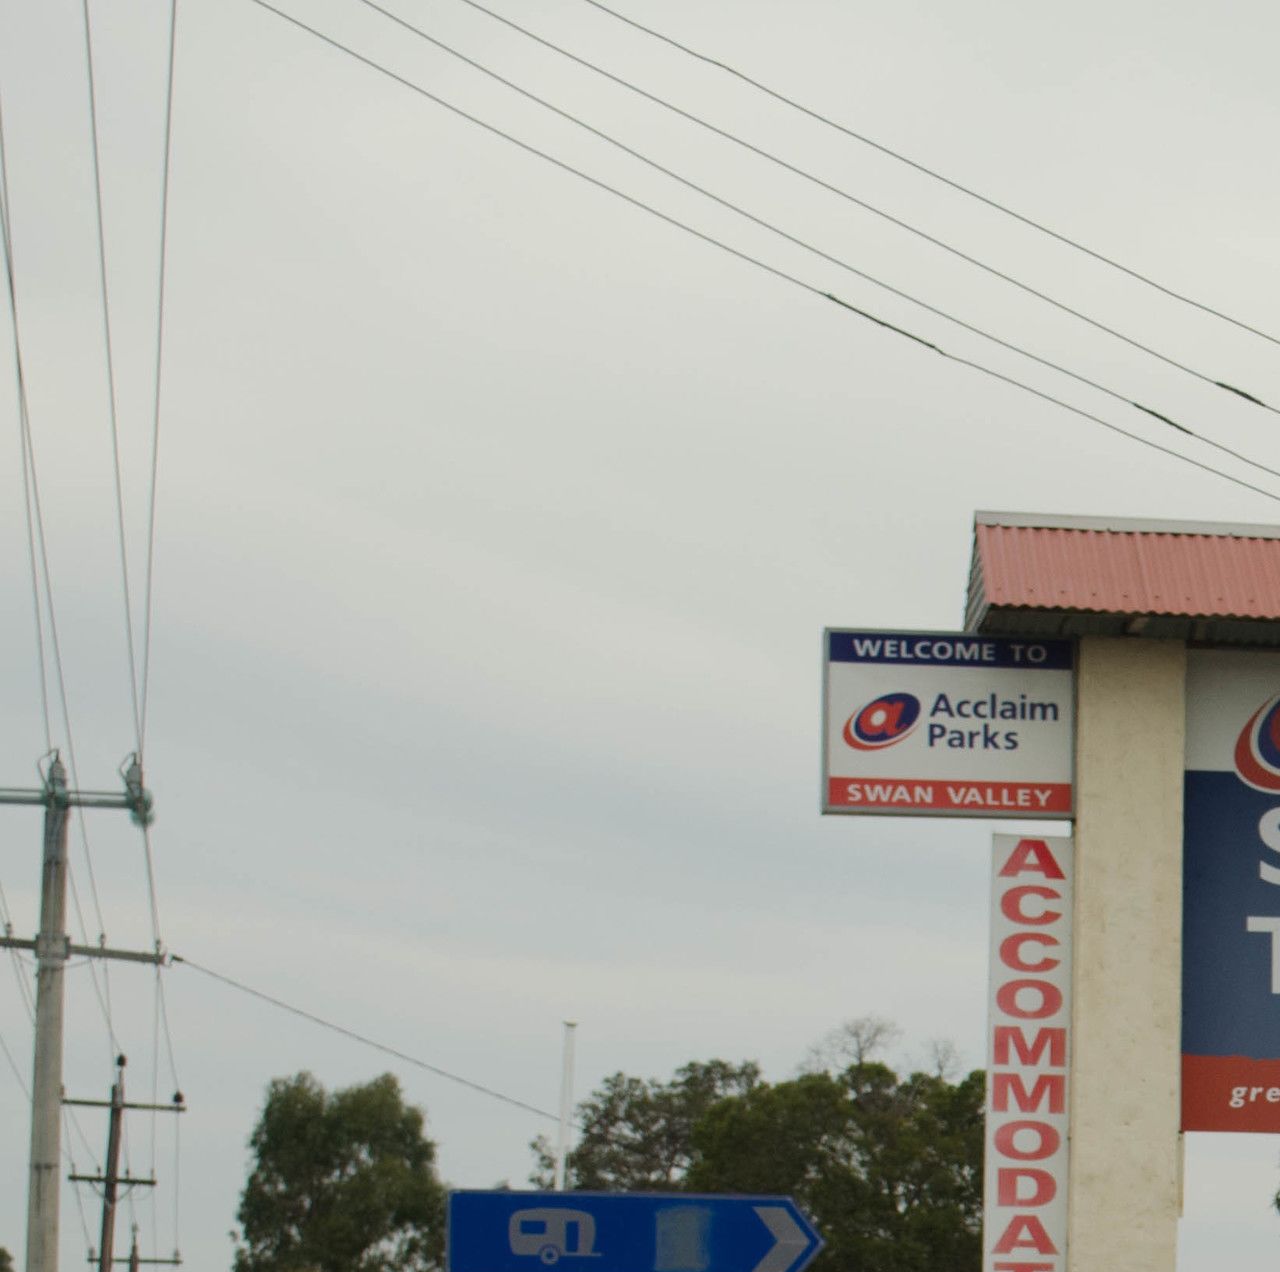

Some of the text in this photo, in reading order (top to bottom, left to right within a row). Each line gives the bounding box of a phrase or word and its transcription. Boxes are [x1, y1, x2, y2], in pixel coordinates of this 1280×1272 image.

[852, 638, 1048, 664] WELCOME TO
[930, 692, 1060, 722] Acclaim
[927, 724, 1019, 751] Parks
[846, 783, 1053, 808] SWAN VALLEY
